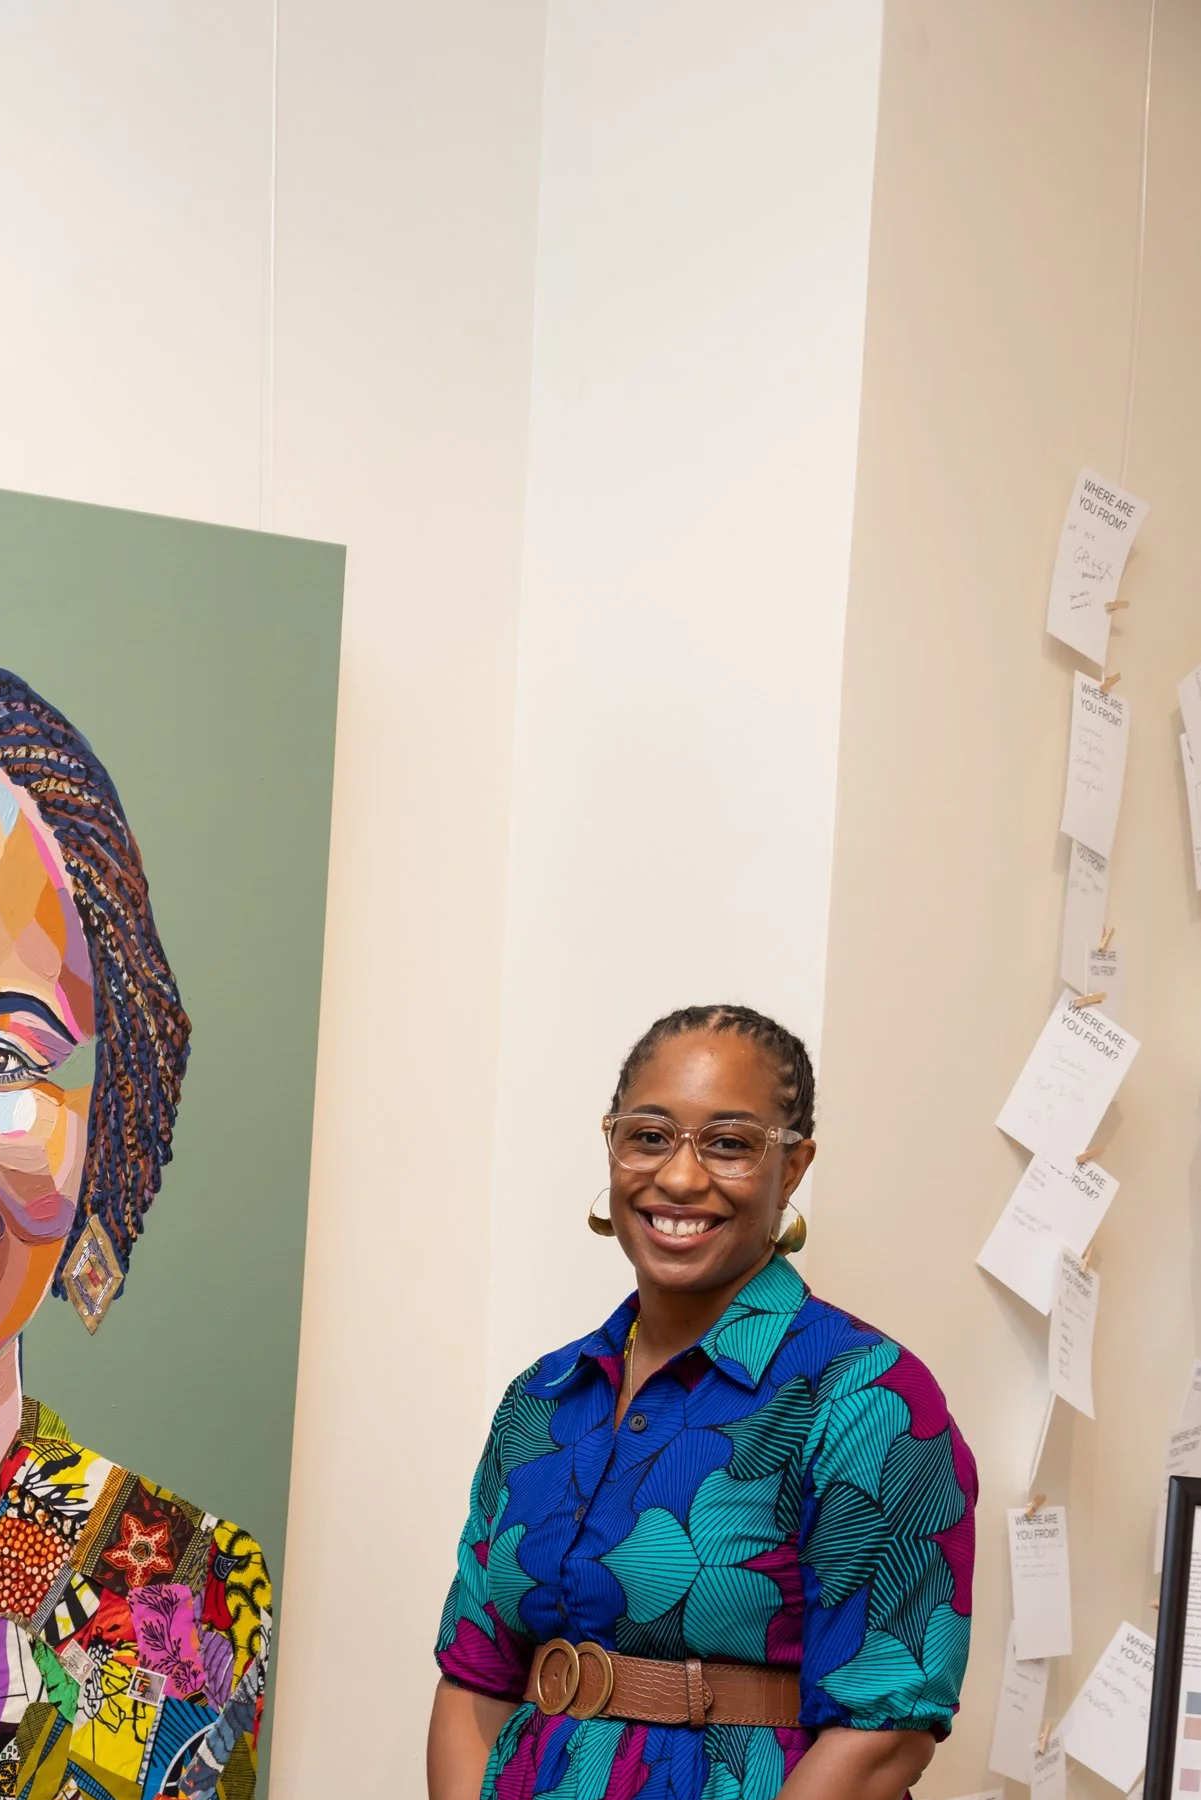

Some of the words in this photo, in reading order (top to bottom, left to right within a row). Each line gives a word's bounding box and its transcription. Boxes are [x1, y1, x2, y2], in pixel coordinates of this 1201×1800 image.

[1079, 494, 1098, 515] YOU
[1097, 507, 1128, 532] FROM?
[1083, 478, 1116, 507] WHERE
[1114, 499, 1136, 518] ARE
[1080, 681, 1109, 706] WHERE
[1109, 697, 1124, 715] ARE
[1080, 697, 1097, 714] YOU
[1097, 706, 1123, 729] FROM?
[1061, 1013, 1084, 1036] YOU
[1084, 1030, 1120, 1061] FROM?
[1068, 1000, 1105, 1033] WHERE
[1104, 1029, 1127, 1050] ARE
[1085, 1168, 1107, 1190] ARE
[1014, 1514, 1043, 1526] WHERE
[1043, 1513, 1059, 1525] ARE
[1016, 1529, 1034, 1541] YOU
[1034, 1528, 1060, 1540] FROM?
[1120, 1644, 1143, 1666] YOU
[1126, 1632, 1155, 1657] WHER
